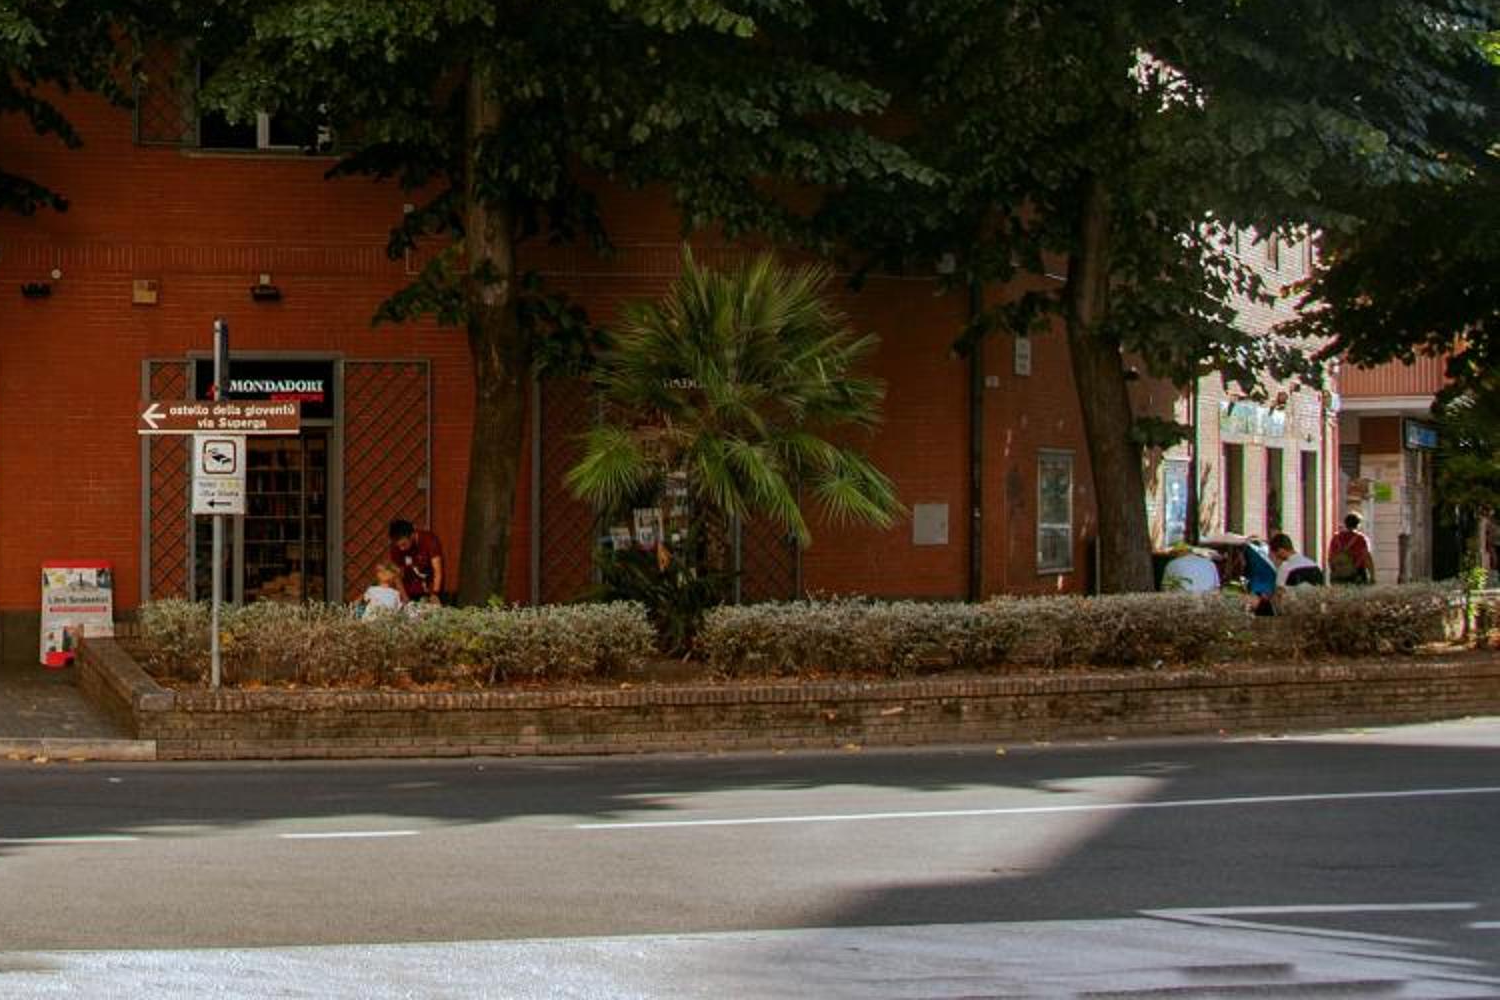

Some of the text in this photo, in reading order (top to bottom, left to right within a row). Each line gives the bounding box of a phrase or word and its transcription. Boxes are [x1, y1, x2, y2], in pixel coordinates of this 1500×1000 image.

[228, 379, 324, 393] MONDADORI
[169, 403, 296, 418] ostello della gioventù
[197, 417, 267, 430] via Superga
